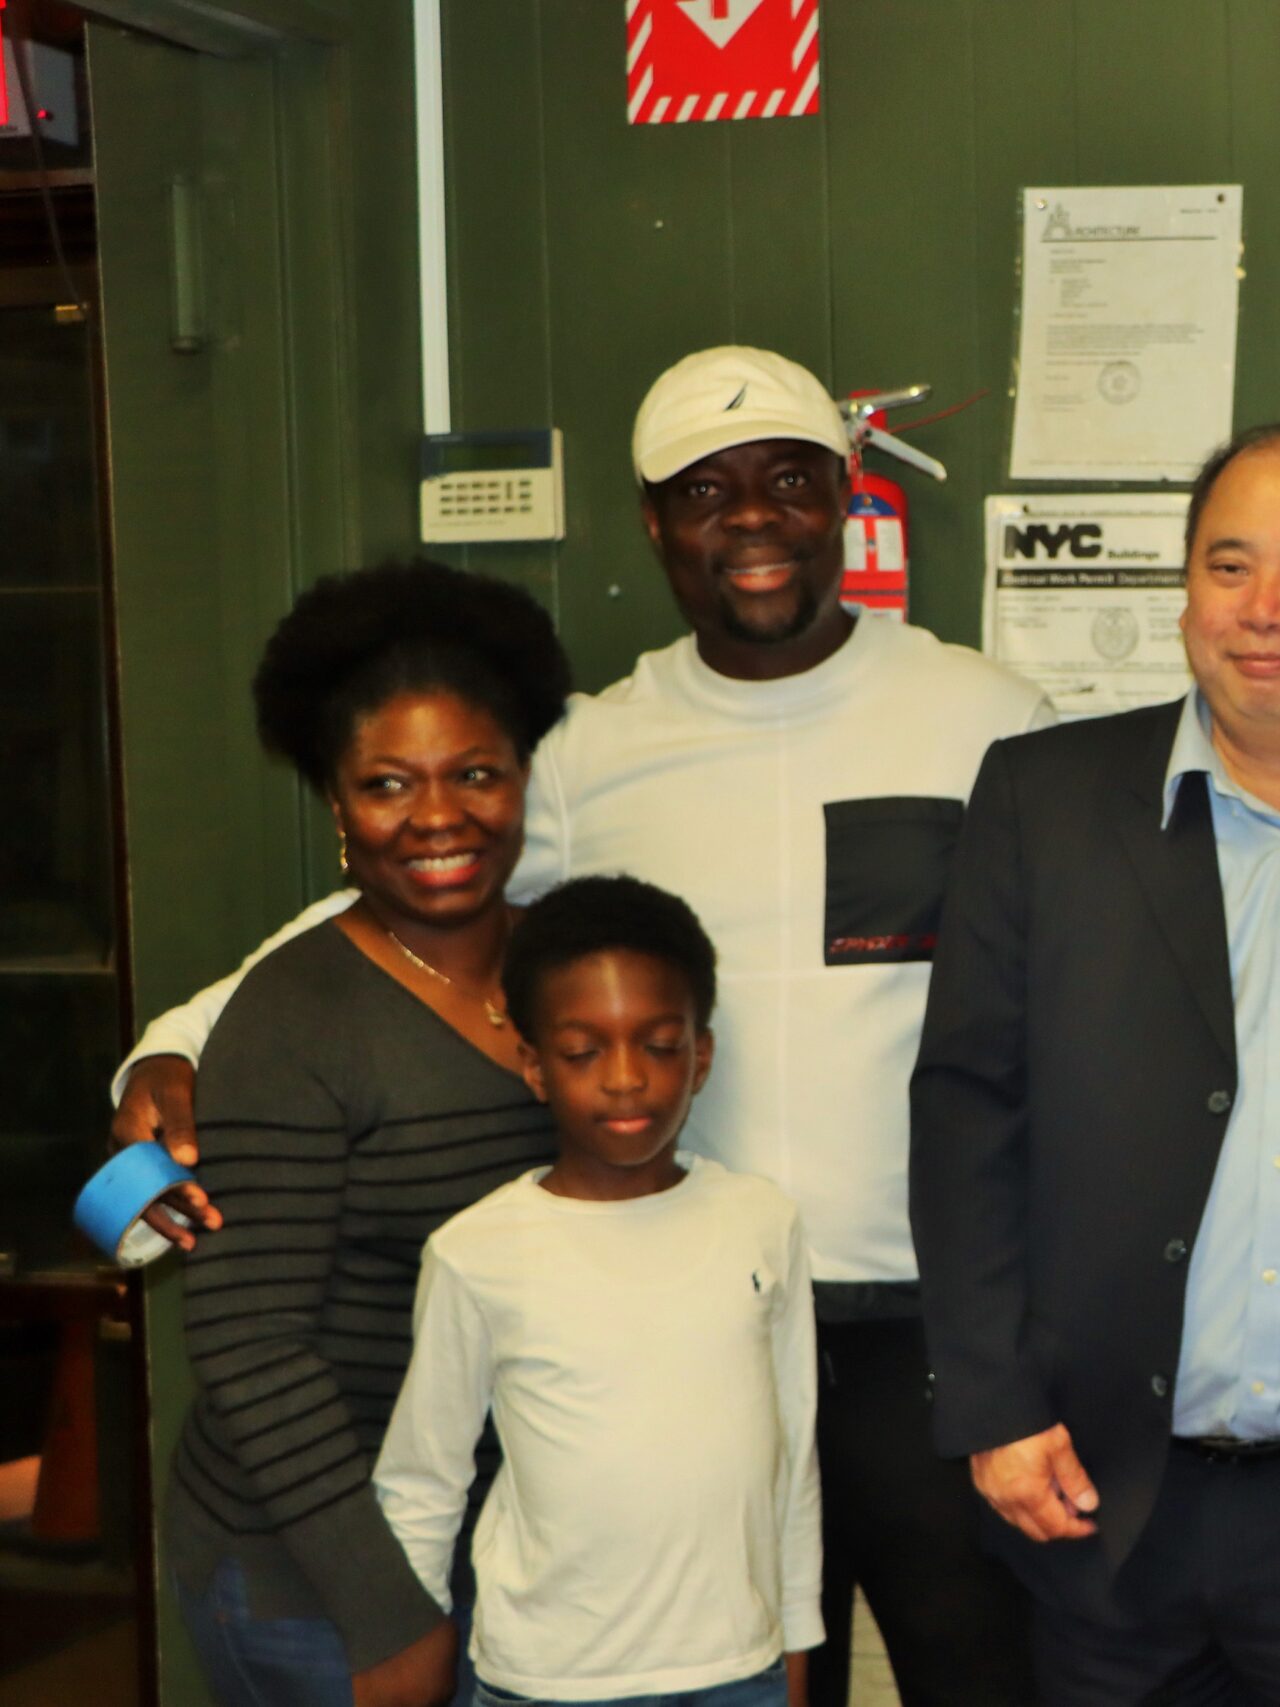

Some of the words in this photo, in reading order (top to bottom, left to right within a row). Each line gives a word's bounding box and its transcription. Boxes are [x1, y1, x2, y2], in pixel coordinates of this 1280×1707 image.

[1004, 523, 1102, 559] NYC
[1107, 551, 1160, 562] Buildings
[1049, 574, 1076, 585] Work
[1078, 573, 1115, 585] Permit
[1118, 574, 1179, 586] Department
